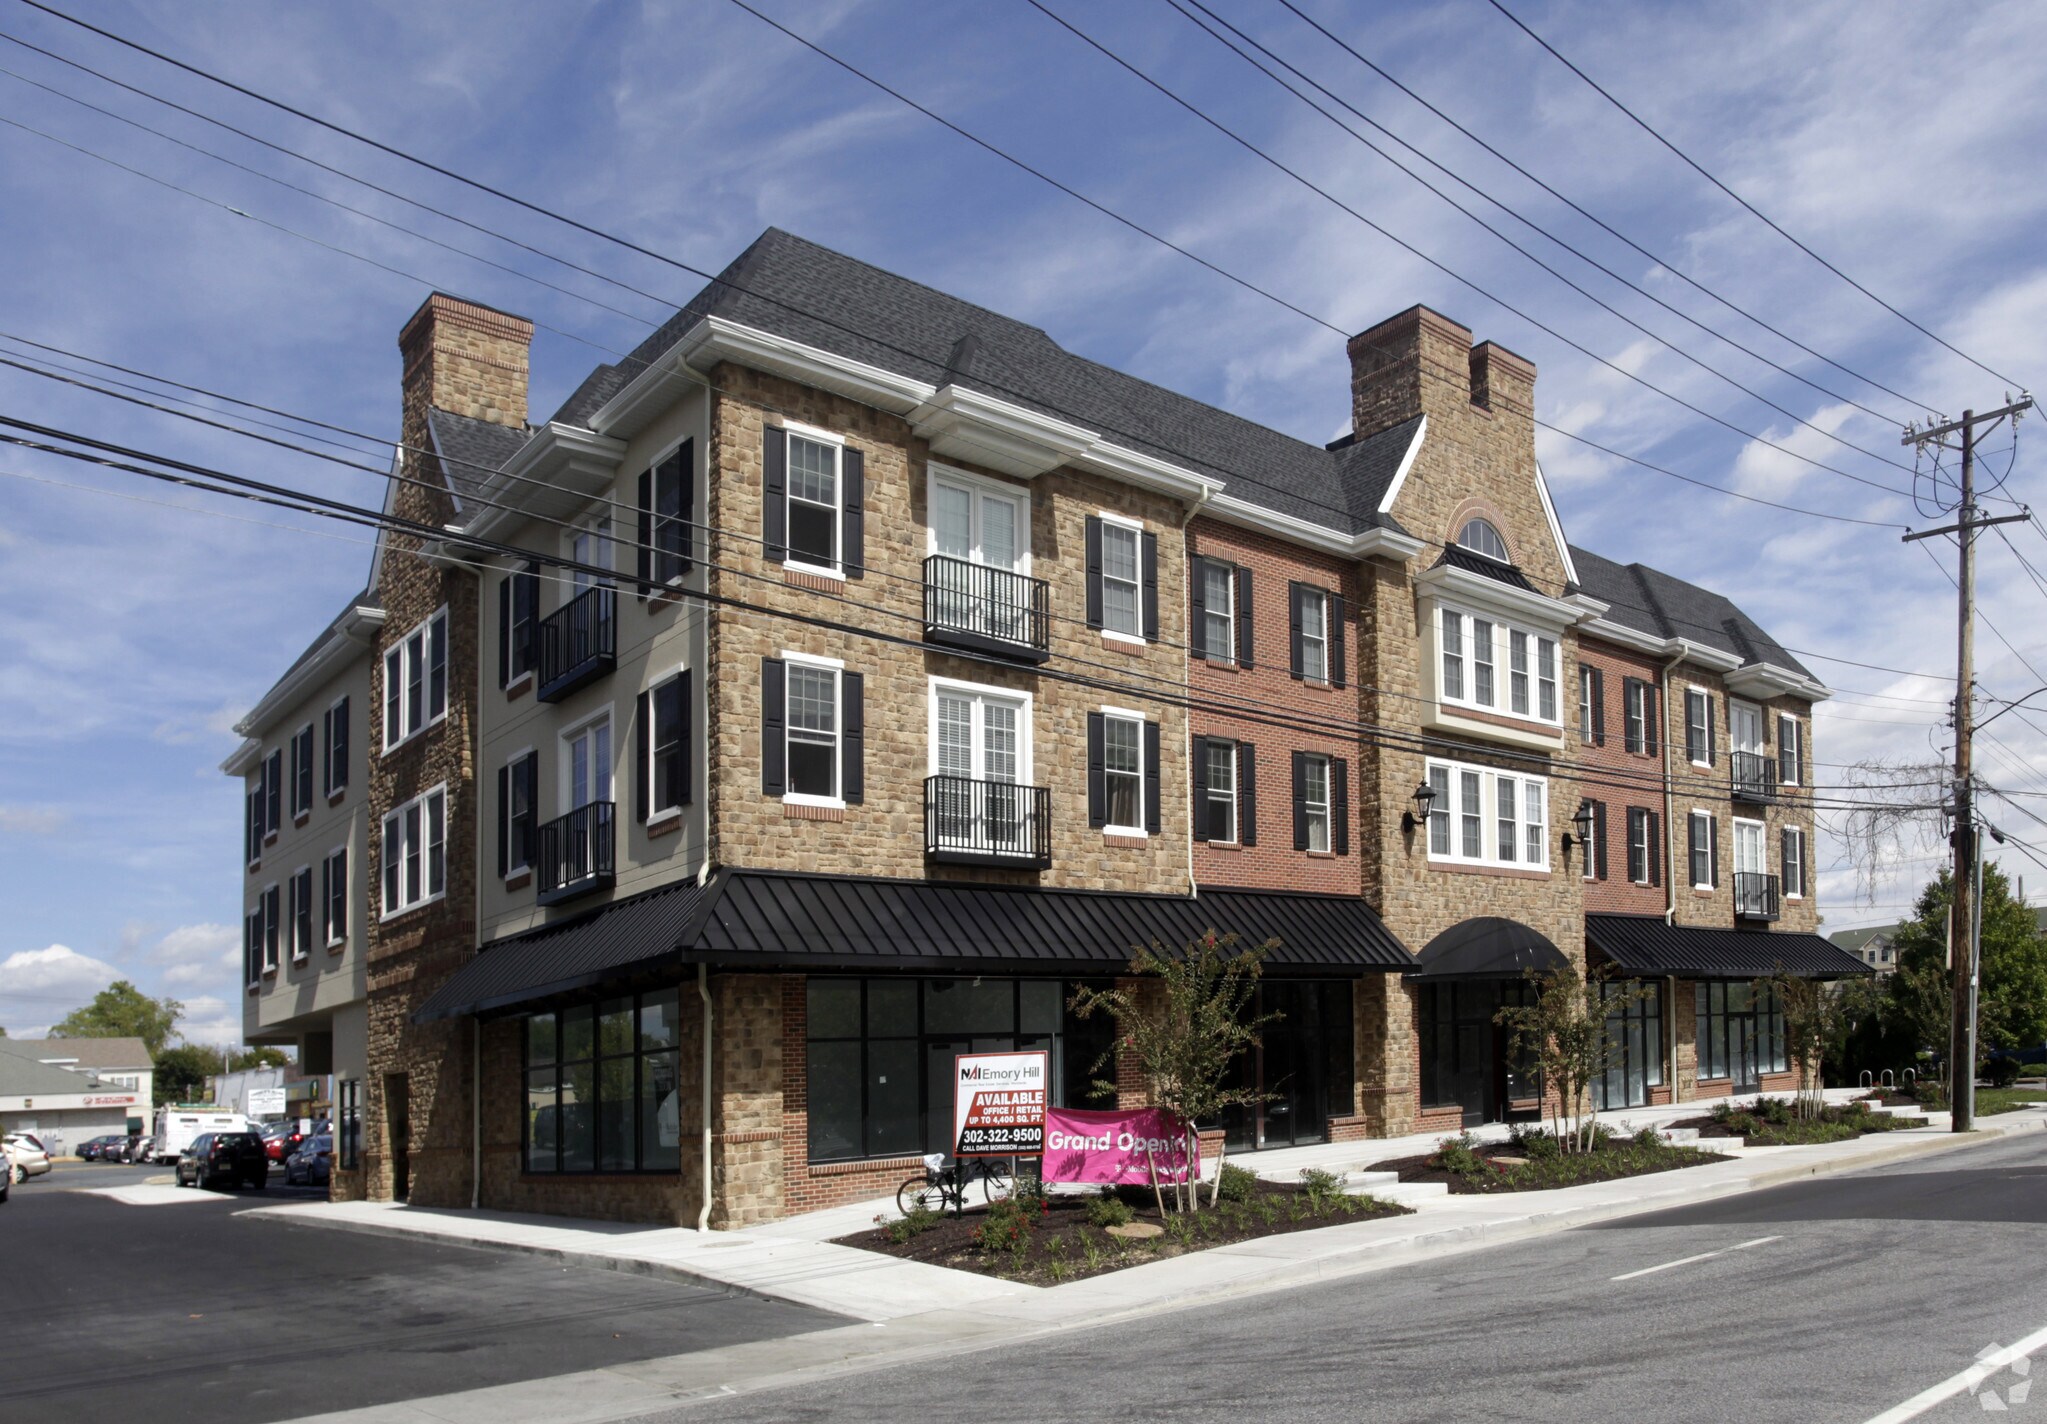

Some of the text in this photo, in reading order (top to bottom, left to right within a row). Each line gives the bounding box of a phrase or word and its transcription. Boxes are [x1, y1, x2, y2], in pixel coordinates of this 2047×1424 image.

[961, 1063, 1040, 1081] NAI Emory Hill
[976, 1091, 1044, 1106] AVAILABLE
[983, 1107, 1009, 1115] OFFICE
[1016, 1106, 1043, 1114] RETAIL
[969, 1114, 1043, 1125] UP TO 4,400 SQ. FT.
[963, 1128, 1042, 1143] 302-322-9500
[1048, 1131, 1111, 1150] Grand
